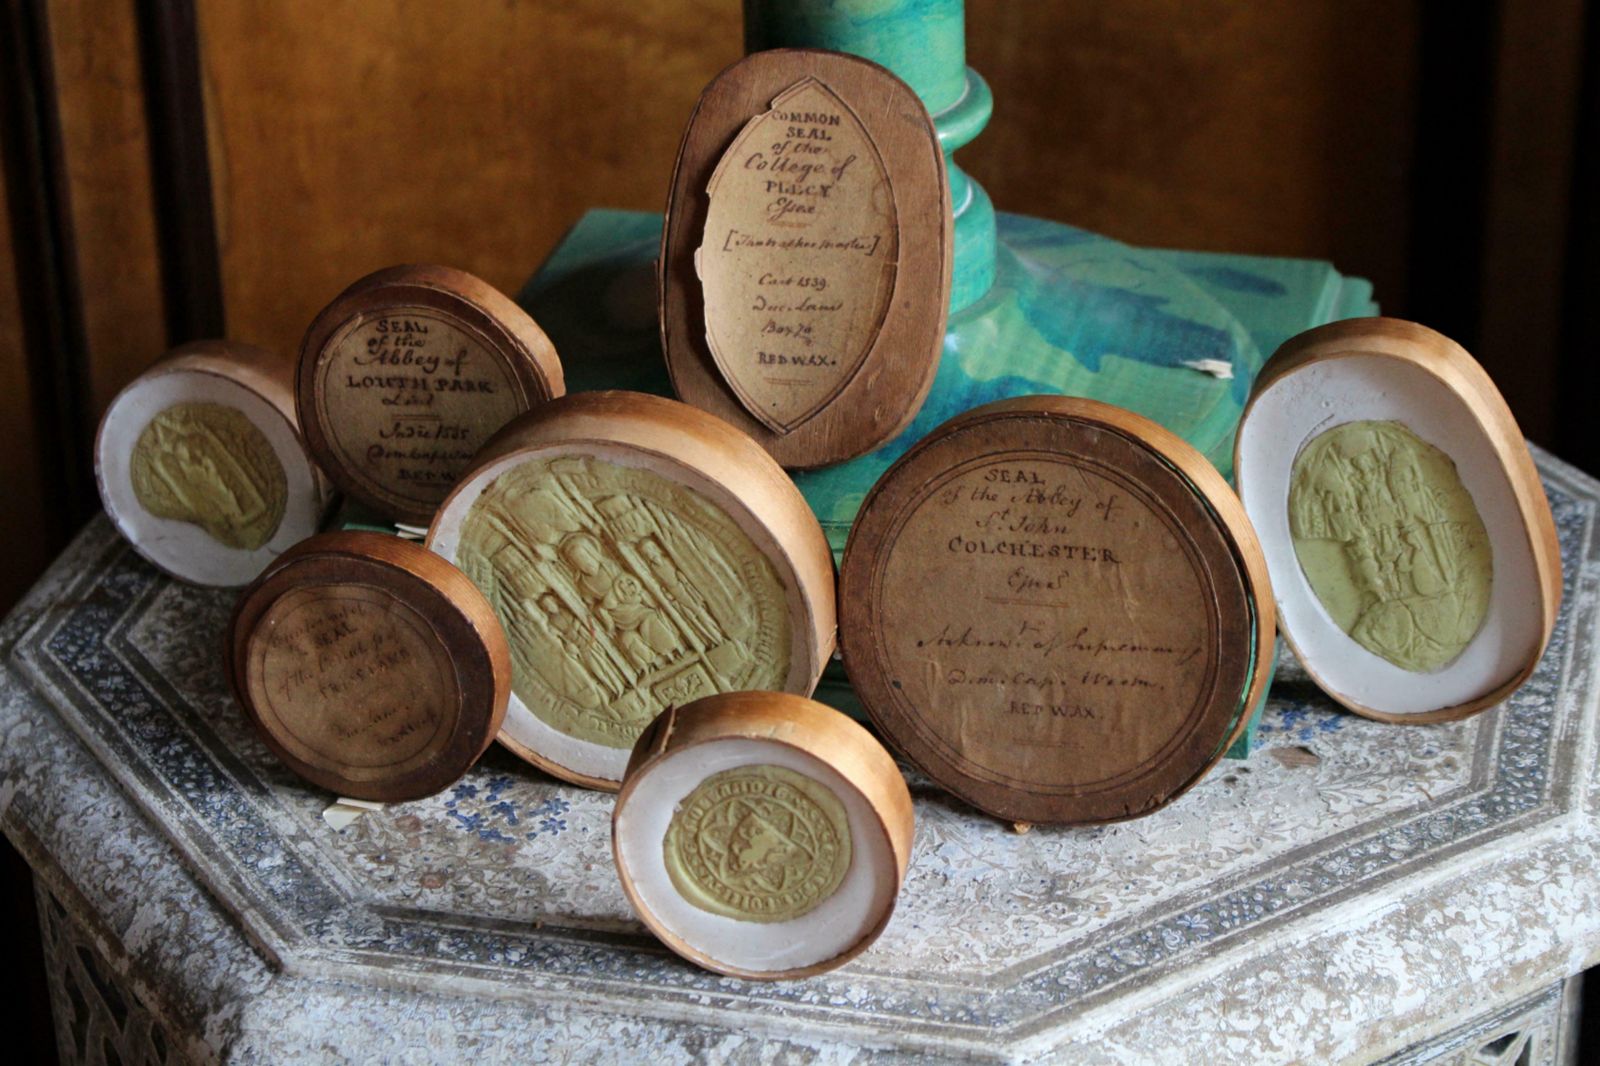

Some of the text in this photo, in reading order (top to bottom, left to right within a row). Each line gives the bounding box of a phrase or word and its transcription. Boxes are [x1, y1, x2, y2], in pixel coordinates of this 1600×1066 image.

[772, 111, 840, 127] COMMON
[771, 140, 821, 155] of the
[743, 152, 858, 183] College of
[375, 319, 429, 334] SEAL
[367, 334, 427, 354] of the
[353, 347, 473, 376] Abbey of
[757, 351, 788, 366] RED
[345, 374, 496, 394] LOUTH PARK
[984, 469, 1046, 485] SEAL
[941, 485, 1124, 521] of the Abbey of
[1010, 515, 1067, 534] John
[948, 535, 1122, 564] COLCHESTER
[1004, 701, 1043, 716] RED
